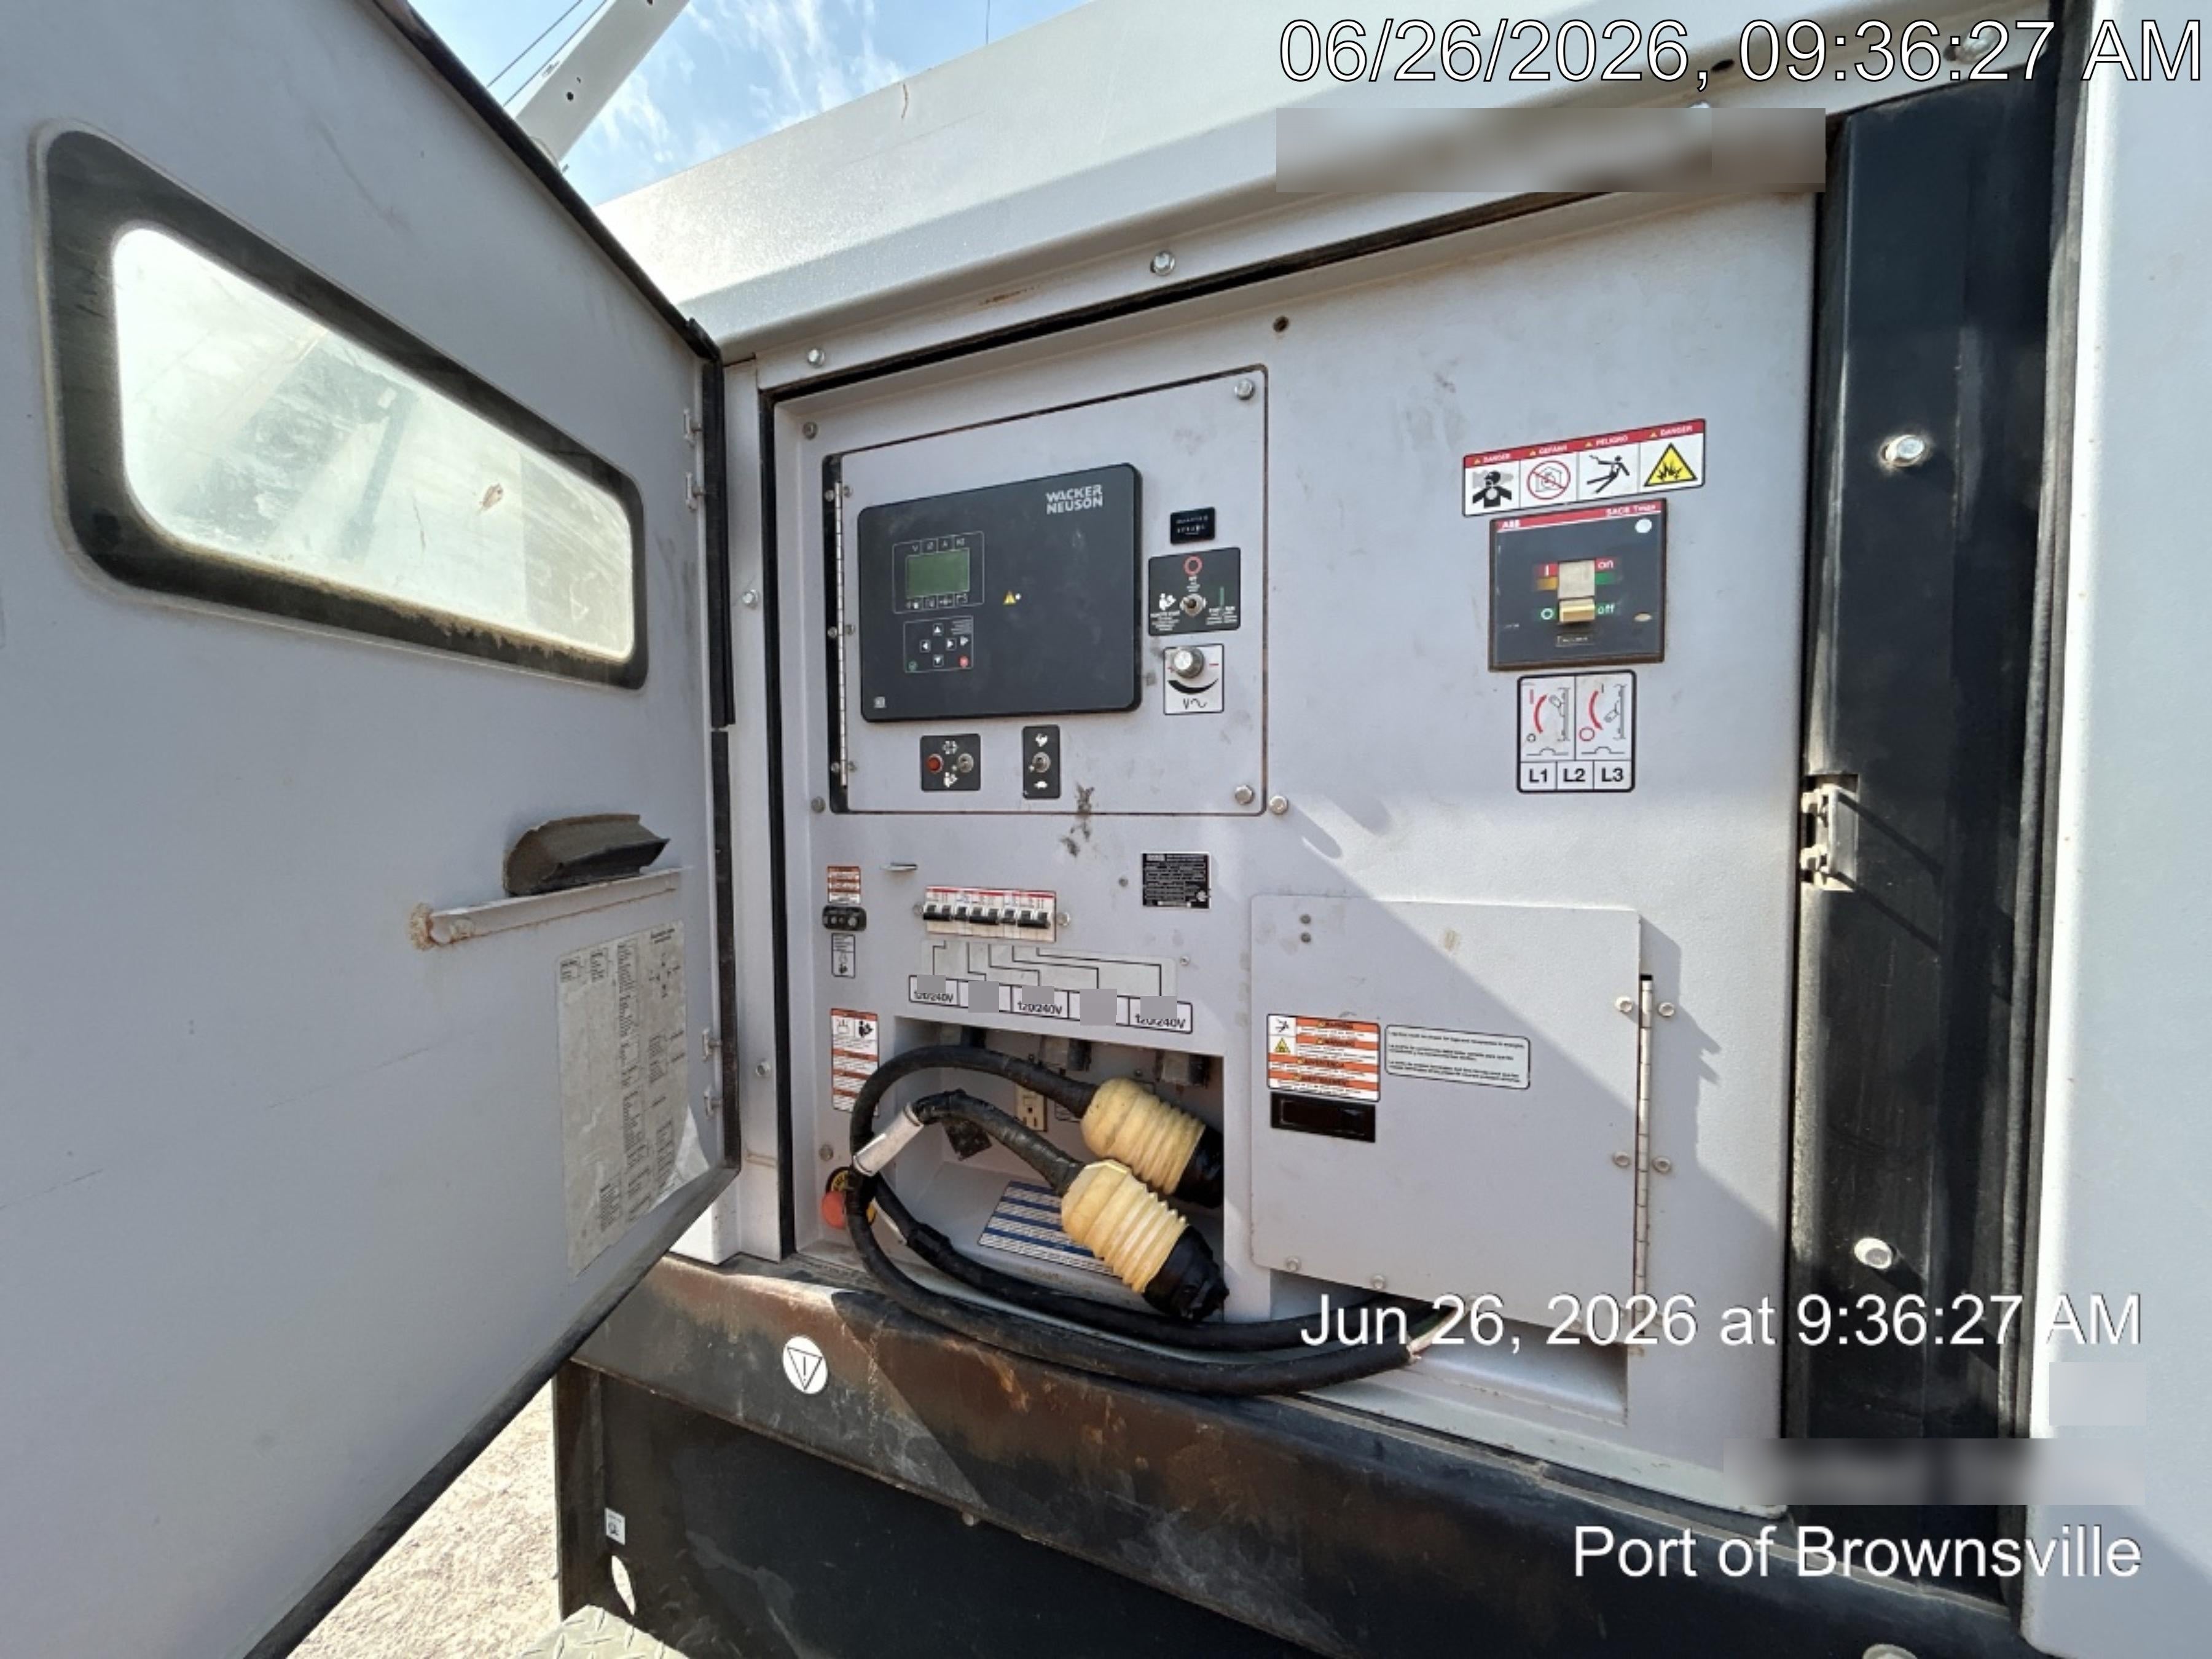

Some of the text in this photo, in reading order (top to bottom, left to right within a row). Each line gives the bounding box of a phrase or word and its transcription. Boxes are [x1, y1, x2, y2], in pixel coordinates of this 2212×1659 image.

[1660, 425, 1693, 437] DANGER
[1596, 434, 1628, 447] PELIGRO
[1483, 452, 1511, 464] DANGER
[1046, 484, 1104, 503] WACKER
[1046, 495, 1103, 515] NEUSON
[1502, 519, 1520, 528] ABB
[1598, 559, 1614, 570] on
[1598, 604, 1615, 615] off
[1529, 768, 1548, 783] L1
[1563, 767, 1586, 782] L2
[1601, 767, 1624, 782] L3
